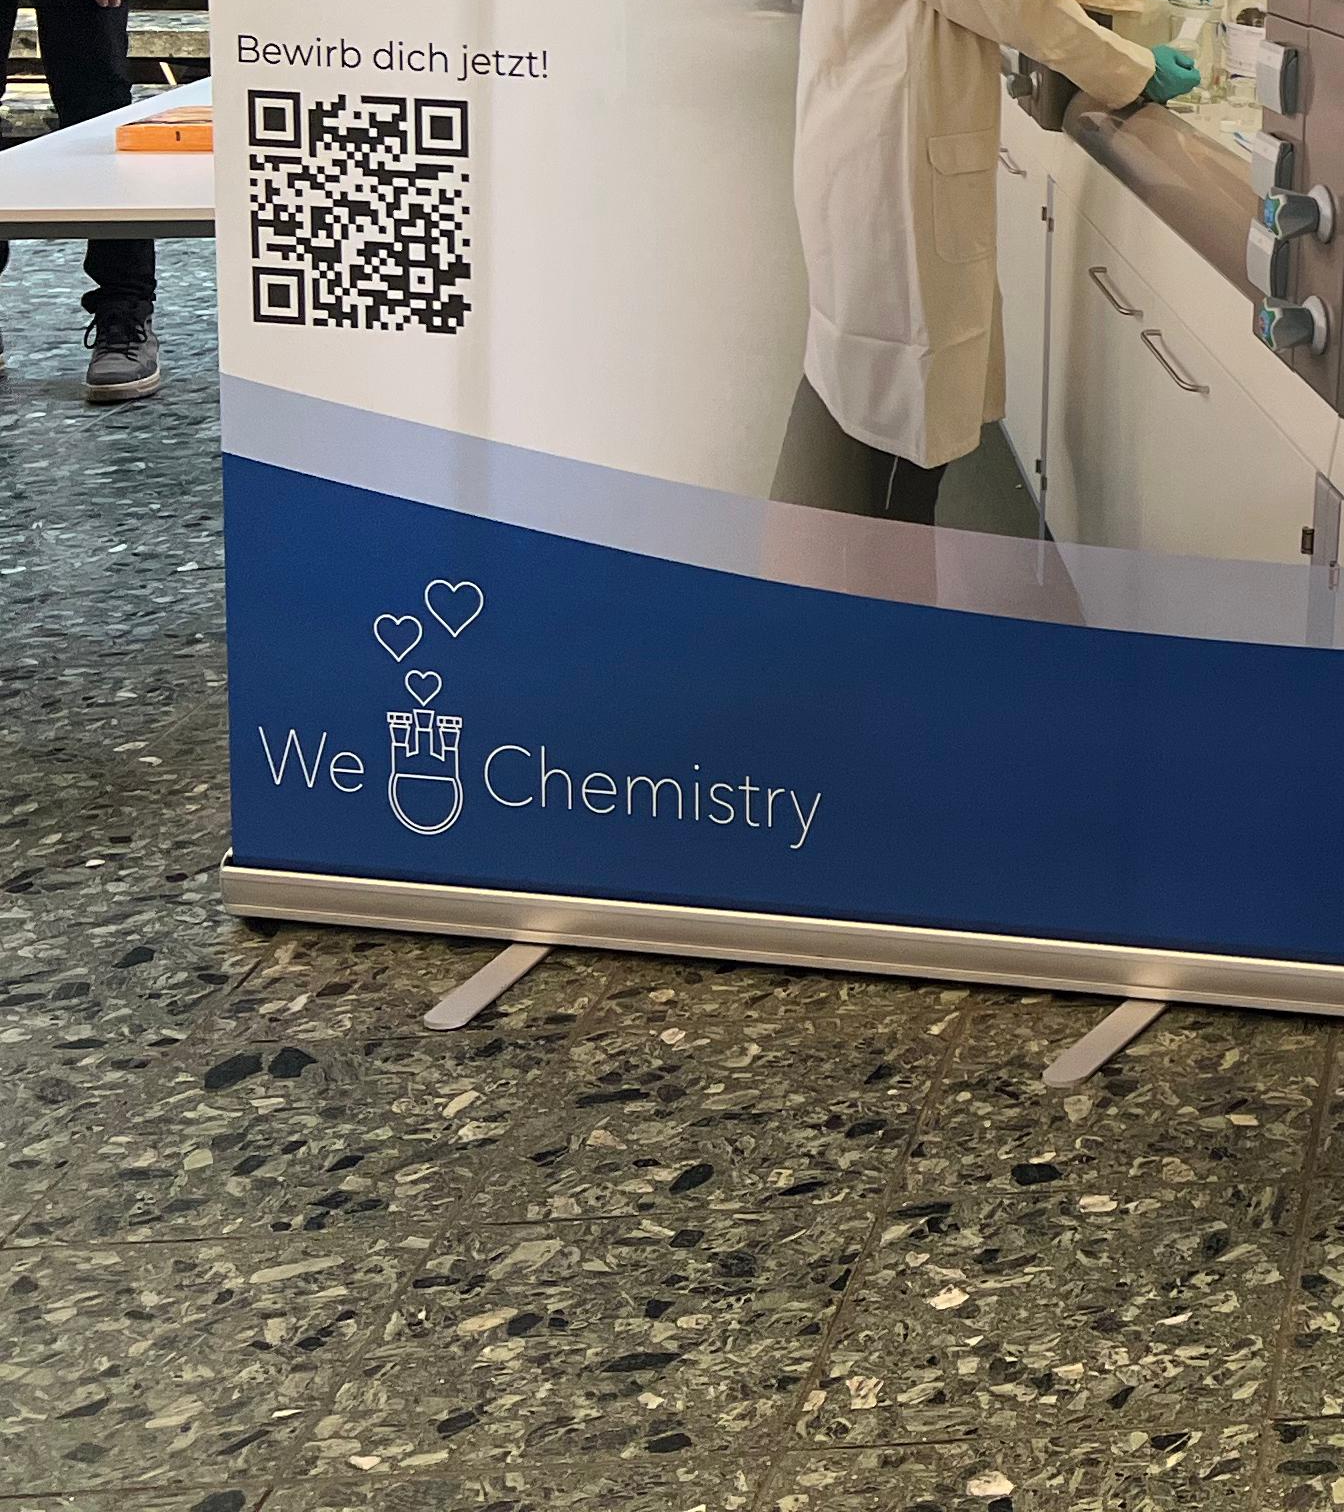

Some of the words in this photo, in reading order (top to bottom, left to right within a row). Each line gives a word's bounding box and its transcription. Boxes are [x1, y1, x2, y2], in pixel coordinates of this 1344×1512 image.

[237, 34, 362, 68] Bewirb
[372, 40, 450, 74] dich
[456, 46, 551, 83] jetzt!
[258, 725, 365, 794] We
[483, 743, 823, 850] Chemistry
